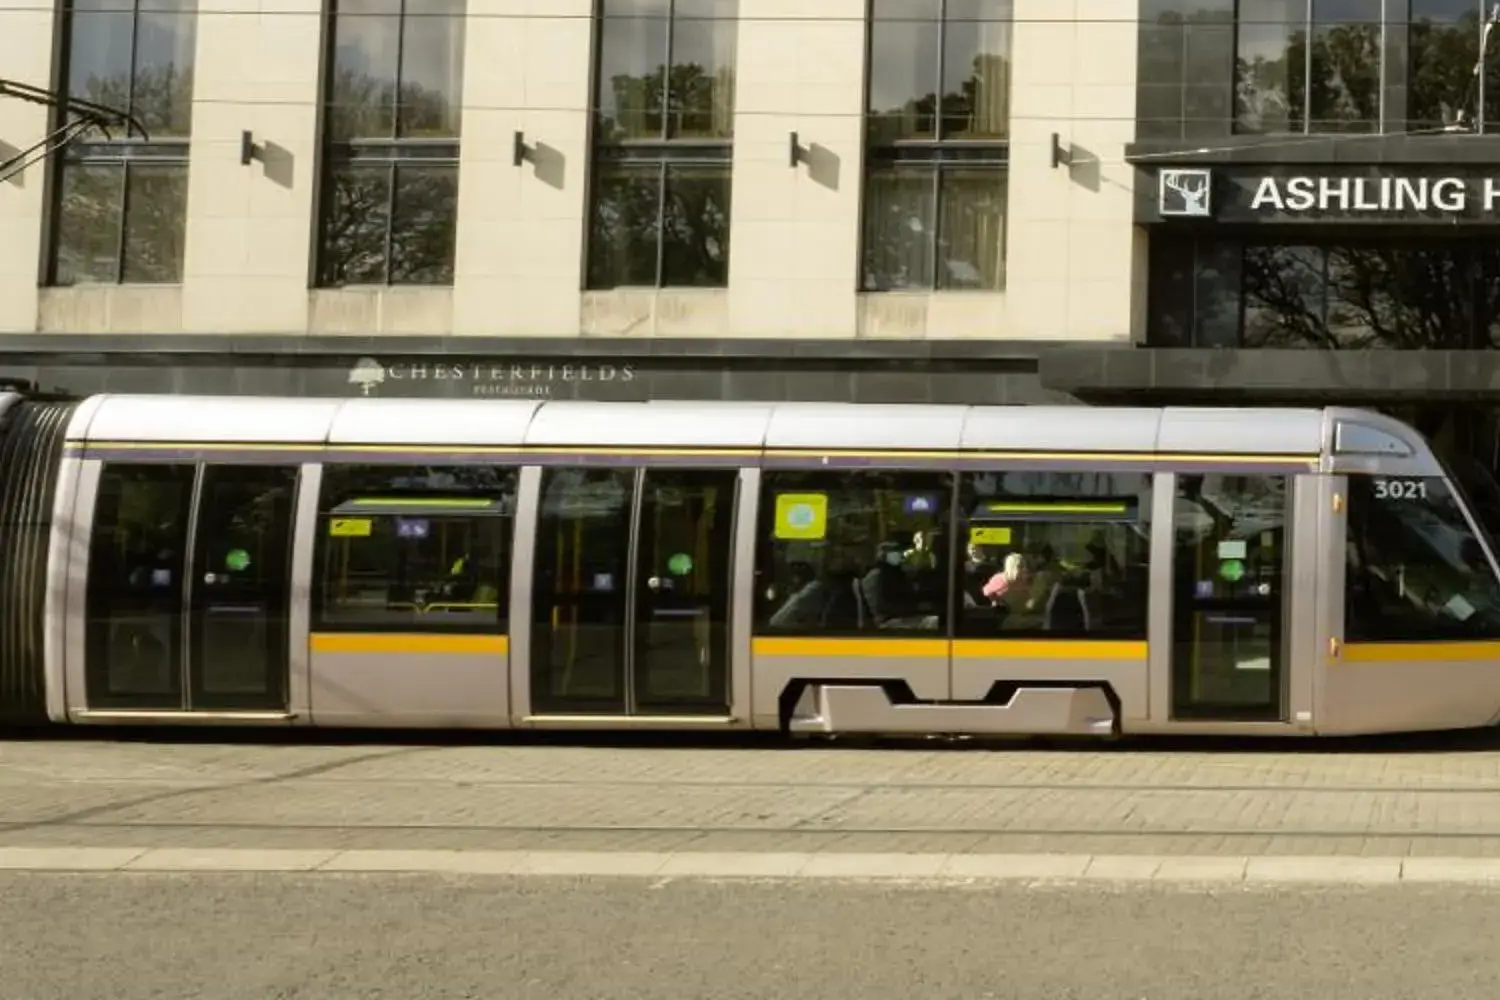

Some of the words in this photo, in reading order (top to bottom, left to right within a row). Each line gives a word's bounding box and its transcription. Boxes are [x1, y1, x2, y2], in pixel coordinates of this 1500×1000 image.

[1250, 177, 1466, 212] ASHLING
[388, 363, 636, 382] CHESTERFIELDS
[1374, 480, 1427, 499] 3021
